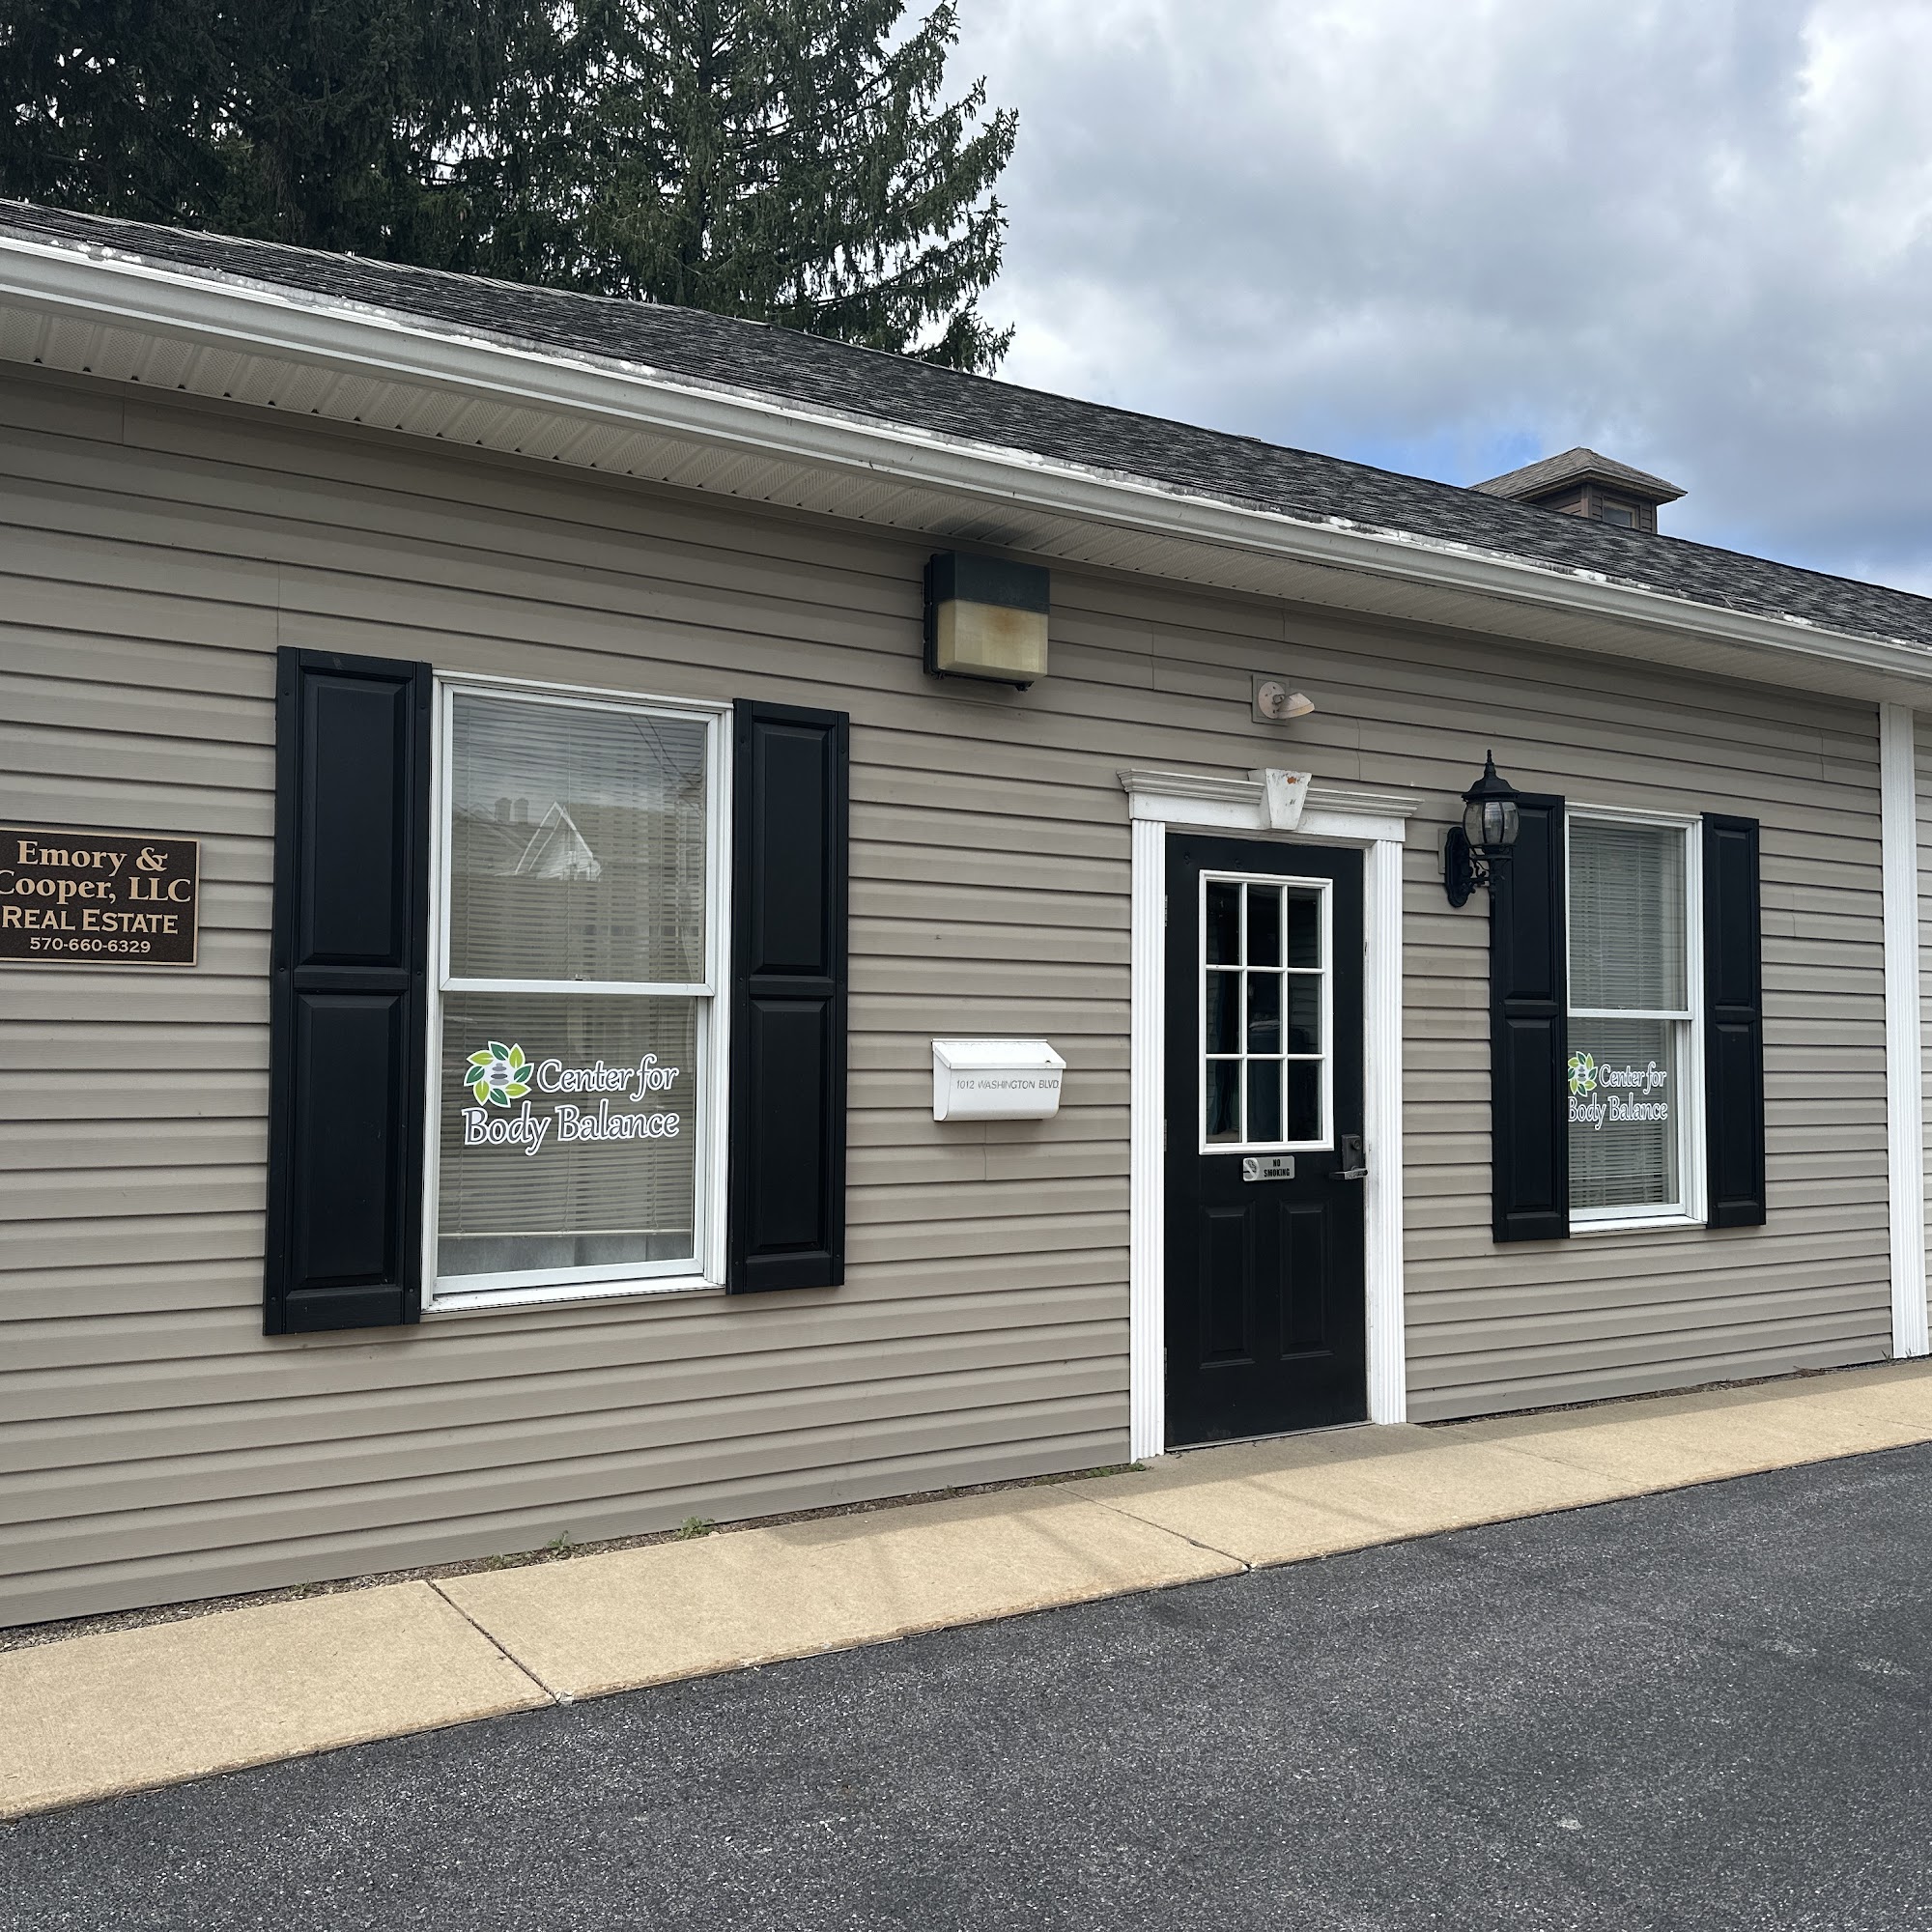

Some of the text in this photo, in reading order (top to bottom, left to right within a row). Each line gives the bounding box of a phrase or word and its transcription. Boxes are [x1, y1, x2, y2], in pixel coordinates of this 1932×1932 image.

[17, 839, 168, 877] Emory &
[0, 869, 191, 905] Cooper, LLC
[2, 905, 179, 935] REAL ESTATE
[30, 937, 152, 953] 570-660-6329
[536, 1053, 680, 1102] Center for
[956, 1080, 975, 1090] 1012
[978, 1080, 1036, 1090] WASHINGTON
[1599, 1061, 1667, 1094] Center for
[461, 1098, 680, 1156] Body Balance
[1567, 1092, 1668, 1130] Body Balance
[1264, 1168, 1291, 1178] SMOKING
[1272, 1158, 1281, 1167] NO
